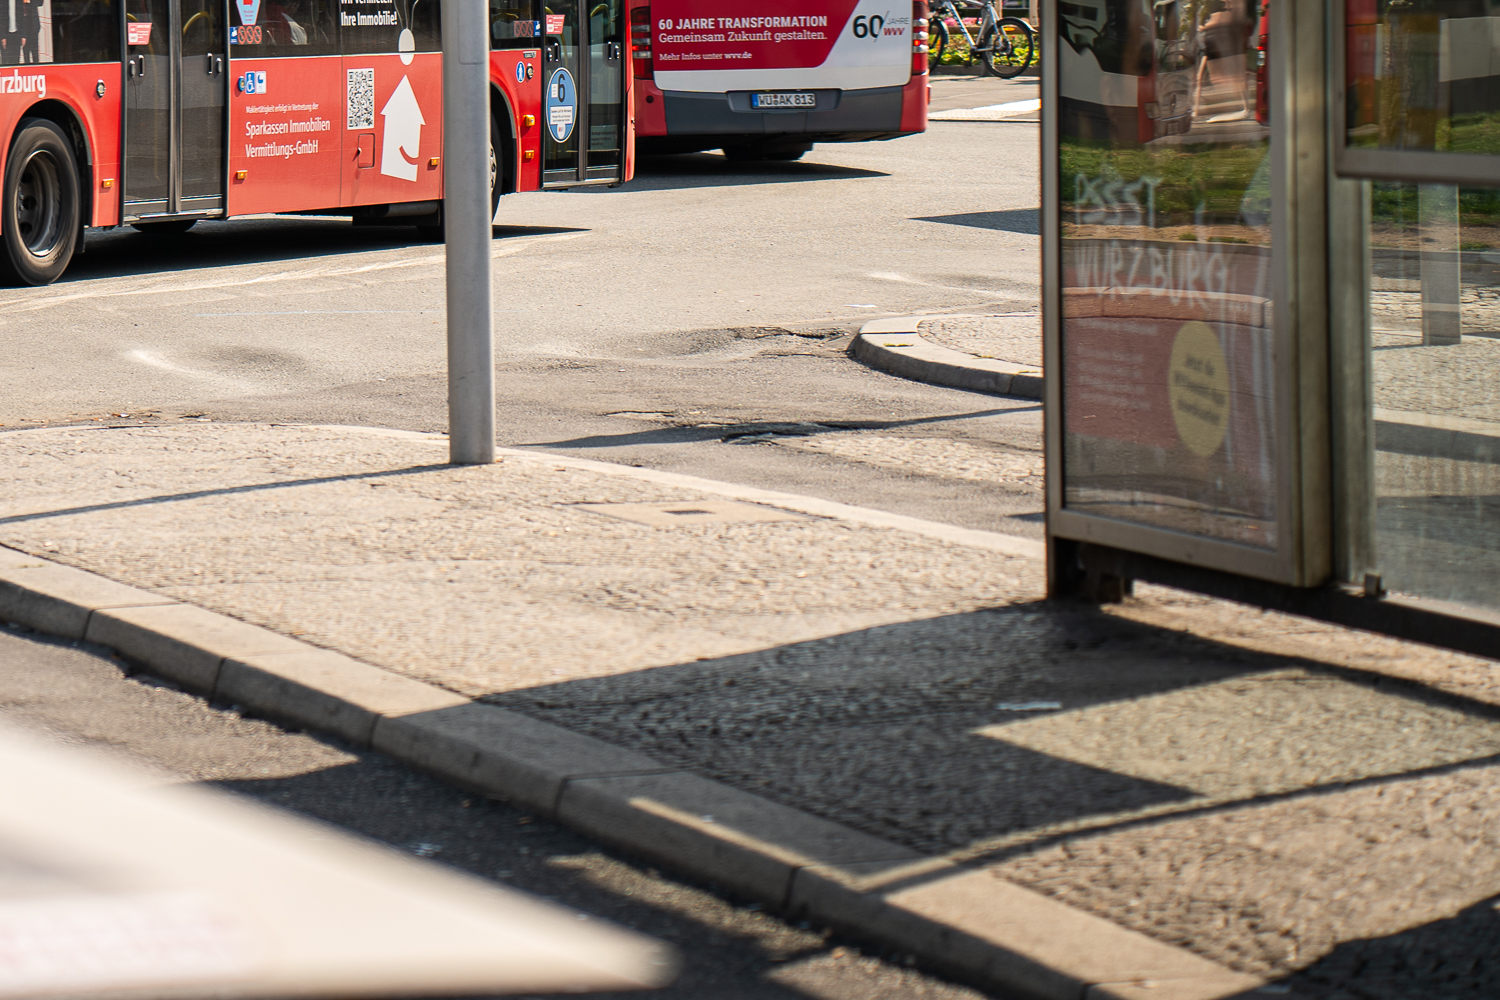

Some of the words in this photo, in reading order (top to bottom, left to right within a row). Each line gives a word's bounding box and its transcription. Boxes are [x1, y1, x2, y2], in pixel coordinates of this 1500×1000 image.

[341, 11, 356, 26] Ihre
[357, 10, 398, 26] Immobilie!
[658, 19, 673, 30] 60
[675, 18, 715, 29] JAHRE
[717, 16, 828, 29] TRANSFORMATION
[886, 17, 910, 25] JAHRE
[852, 14, 884, 39] 60
[658, 32, 725, 43] Gemeinsam
[727, 30, 772, 42] Zukunft
[773, 30, 828, 43] gestalten.
[659, 52, 680, 61] Mehr
[681, 52, 701, 60] Infos
[702, 52, 723, 60] unter
[557, 73, 566, 103] 6
[758, 95, 772, 105] WÜ
[779, 95, 793, 105] AK
[794, 95, 815, 105] 813
[245, 120, 289, 139] Sparkassen
[289, 117, 331, 133] Immobilien
[245, 139, 319, 160] Vermittlungs-GmbH
